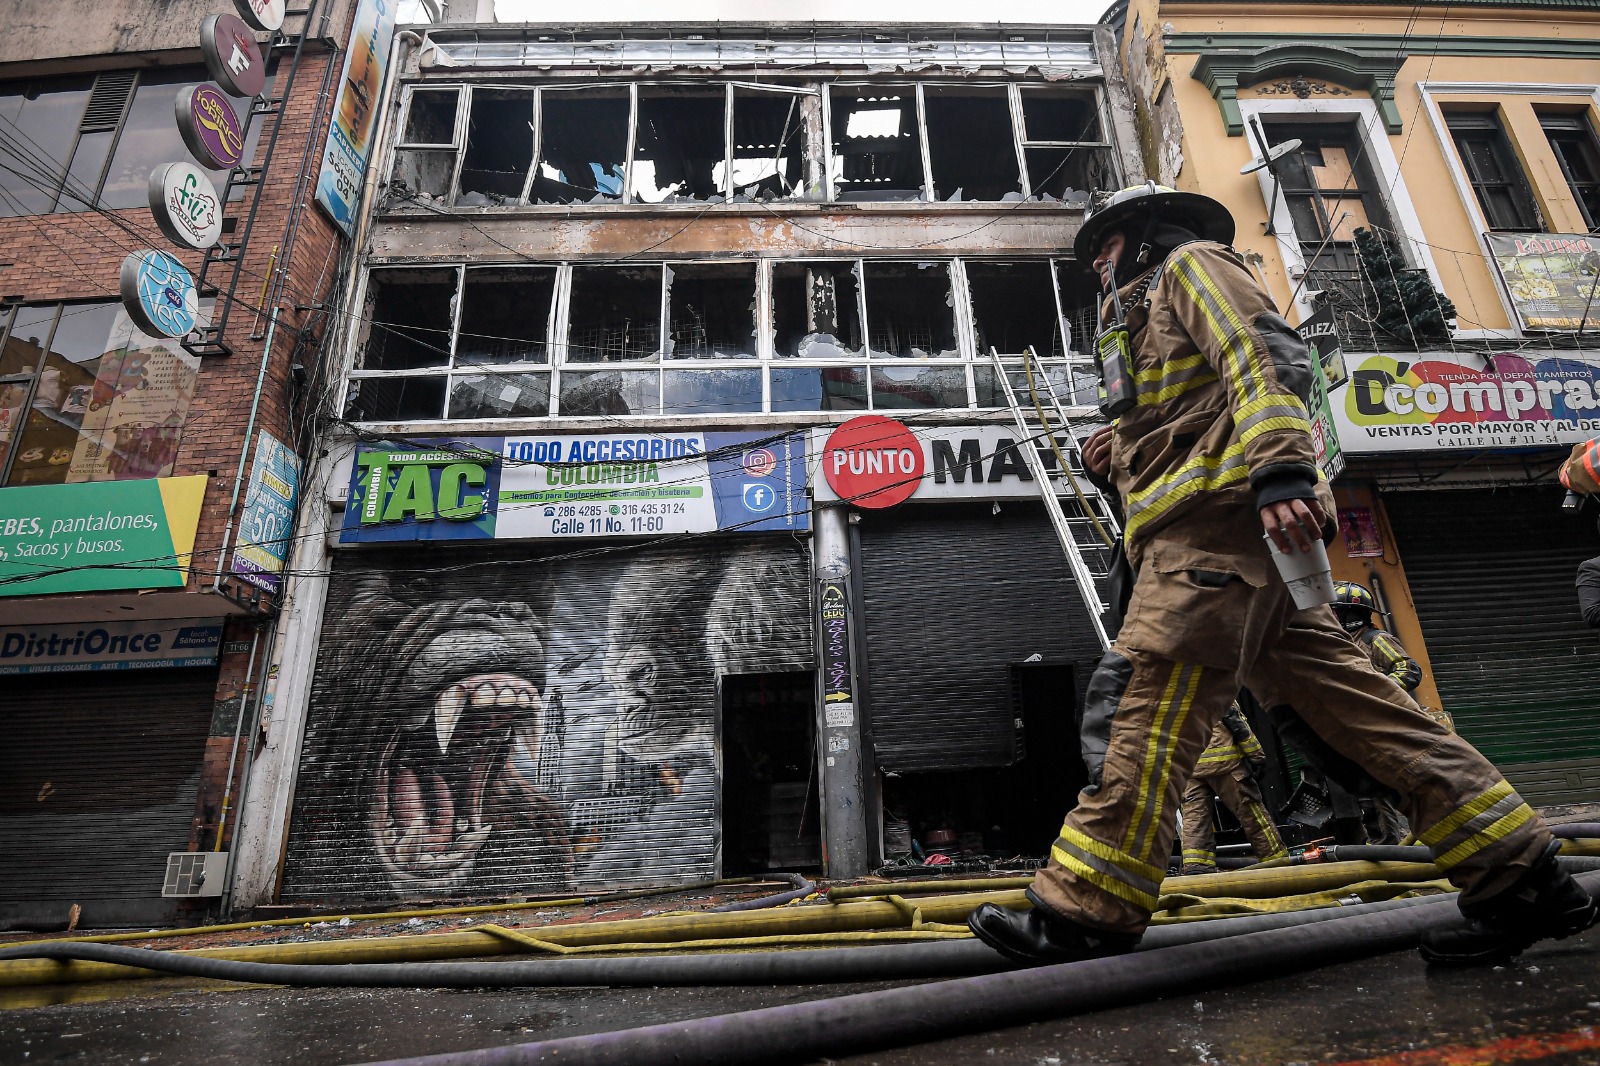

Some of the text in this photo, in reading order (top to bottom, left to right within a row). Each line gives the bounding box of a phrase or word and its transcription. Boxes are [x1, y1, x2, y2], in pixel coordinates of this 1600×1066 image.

[336, 179, 350, 201] 04
[1514, 239, 1593, 254] LATINO
[1438, 373, 1474, 381] TIENDA
[1503, 370, 1593, 380] DEPARTAMENTOS
[1366, 425, 1434, 438] VENTAS
[1438, 424, 1473, 436] POR
[1478, 422, 1536, 434] MAYOR
[1540, 422, 1550, 431] Y
[1556, 421, 1576, 431] AL
[1437, 437, 1485, 447] CALLE
[1491, 436, 1503, 445] 11
[1509, 435, 1517, 445] #
[388, 454, 416, 462] TODO
[508, 438, 699, 463] TODO ACCESORIOS
[833, 448, 916, 475] PUNTO
[547, 462, 660, 485] COLOMBIA
[358, 450, 493, 523] TAC
[366, 467, 382, 518] COLOMBIA
[545, 493, 562, 501] para
[558, 507, 577, 517] 286
[579, 506, 602, 516] 4285
[621, 505, 638, 515] 316
[640, 504, 658, 514] 435
[50, 511, 158, 538] pantalones,
[552, 516, 664, 534] Calle 11 No. 11-60
[14, 541, 59, 557] Sacos
[60, 542, 73, 560] y
[76, 537, 125, 554] busos.
[236, 556, 256, 572] ROPA
[243, 571, 278, 594] COMIDAS
[1, 628, 162, 658] DistriOnce
[208, 636, 218, 644] 04
[52, 663, 92, 672] ESCOLARES
[100, 662, 119, 670] ARTE
[128, 659, 174, 668] TECNOLOGÍA
[184, 657, 212, 666] HOGAR
